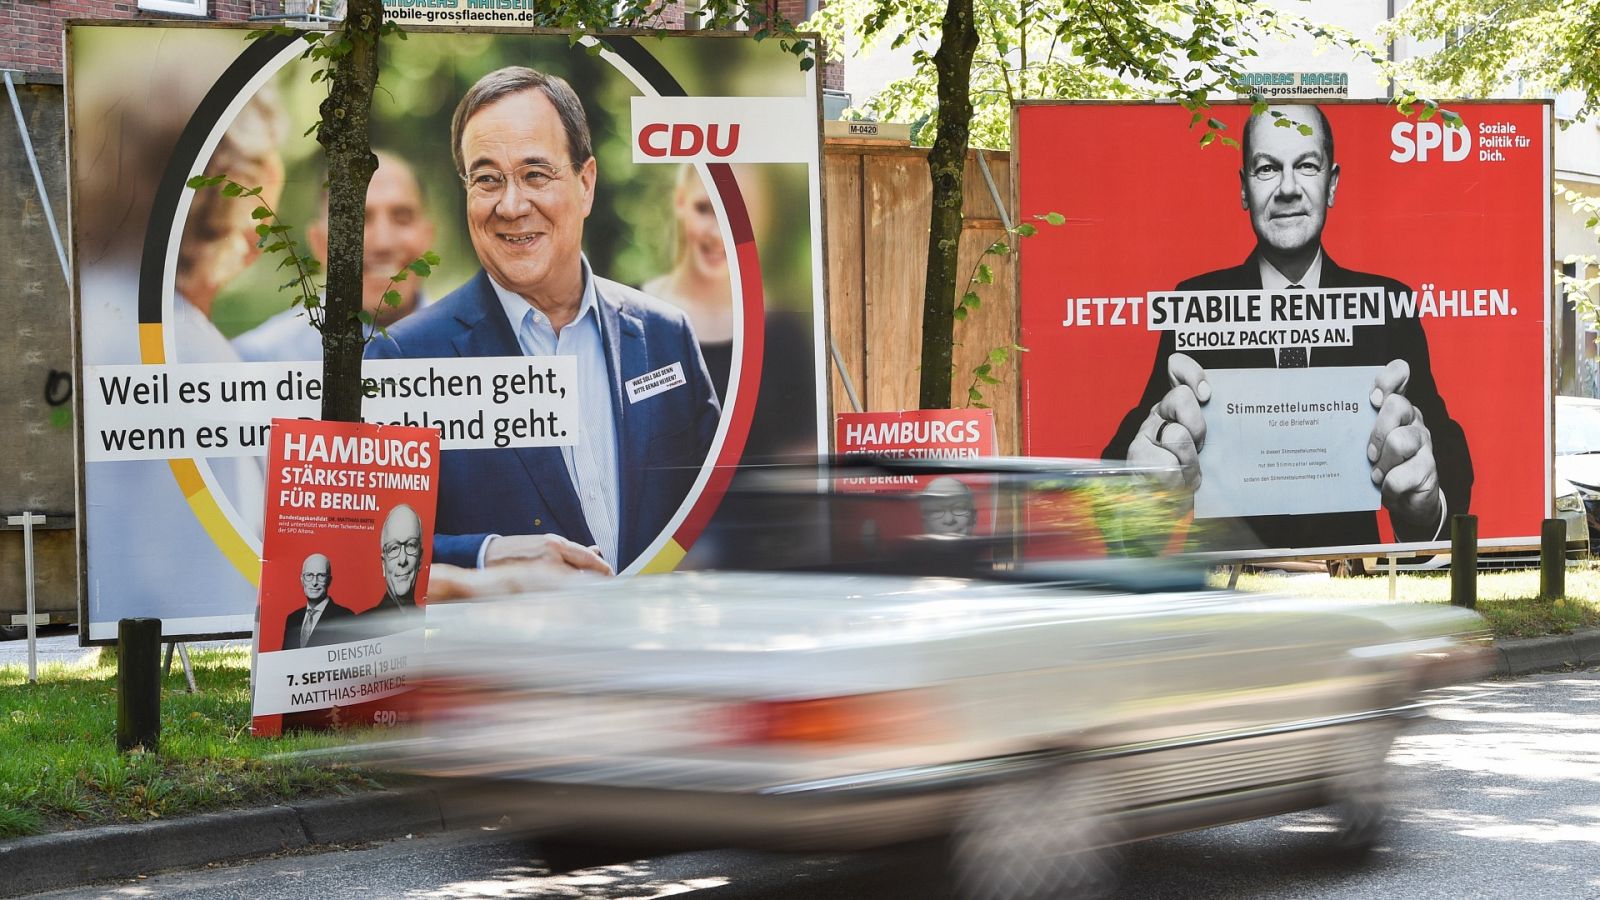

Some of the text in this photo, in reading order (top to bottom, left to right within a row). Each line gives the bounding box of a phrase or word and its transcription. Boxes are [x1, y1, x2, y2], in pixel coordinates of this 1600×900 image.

[1300, 72, 1348, 86] HANSEN
[1243, 85, 1348, 97] obile-grossflaechen.de
[850, 125, 877, 134] M-0420
[1479, 122, 1517, 134] Soziale
[638, 123, 740, 157] CDU
[1390, 121, 1472, 163] SPD
[1479, 136, 1531, 148] Politik für
[1479, 150, 1506, 162] Dich.
[1062, 283, 1518, 327] JETZT STABILE RENTEN WÄHLEN.
[1178, 328, 1351, 347] SCHOLZ PACKT DAS AN.
[99, 373, 169, 405] Weil
[178, 381, 211, 403] es
[221, 380, 267, 402] um
[276, 370, 322, 401] die
[361, 367, 482, 399] enschen
[492, 365, 566, 404] geht,
[632, 379, 643, 387] WAS
[642, 374, 653, 384] SOLL
[652, 371, 662, 380] DAS
[633, 386, 646, 395] BITTE
[1226, 400, 1360, 415] Stimmzettelumschlag
[100, 426, 185, 451] wenn
[196, 426, 228, 448] es
[494, 408, 567, 447] geht.
[846, 420, 981, 446] HAMBURGS
[1268, 419, 1277, 428] für
[283, 432, 432, 469] HAMBURGS
[908, 447, 979, 460] STIMMEN
[281, 464, 430, 491] STÄRKSTE STIMMEN
[279, 486, 380, 512] FÜR BERLIN.
[327, 642, 383, 662] DIENSTAG
[286, 674, 299, 687] 7.
[301, 665, 372, 685] SEPTEMBER
[378, 661, 389, 673] 19
[290, 675, 407, 705] MATTHIAS-BARTKE.DE
